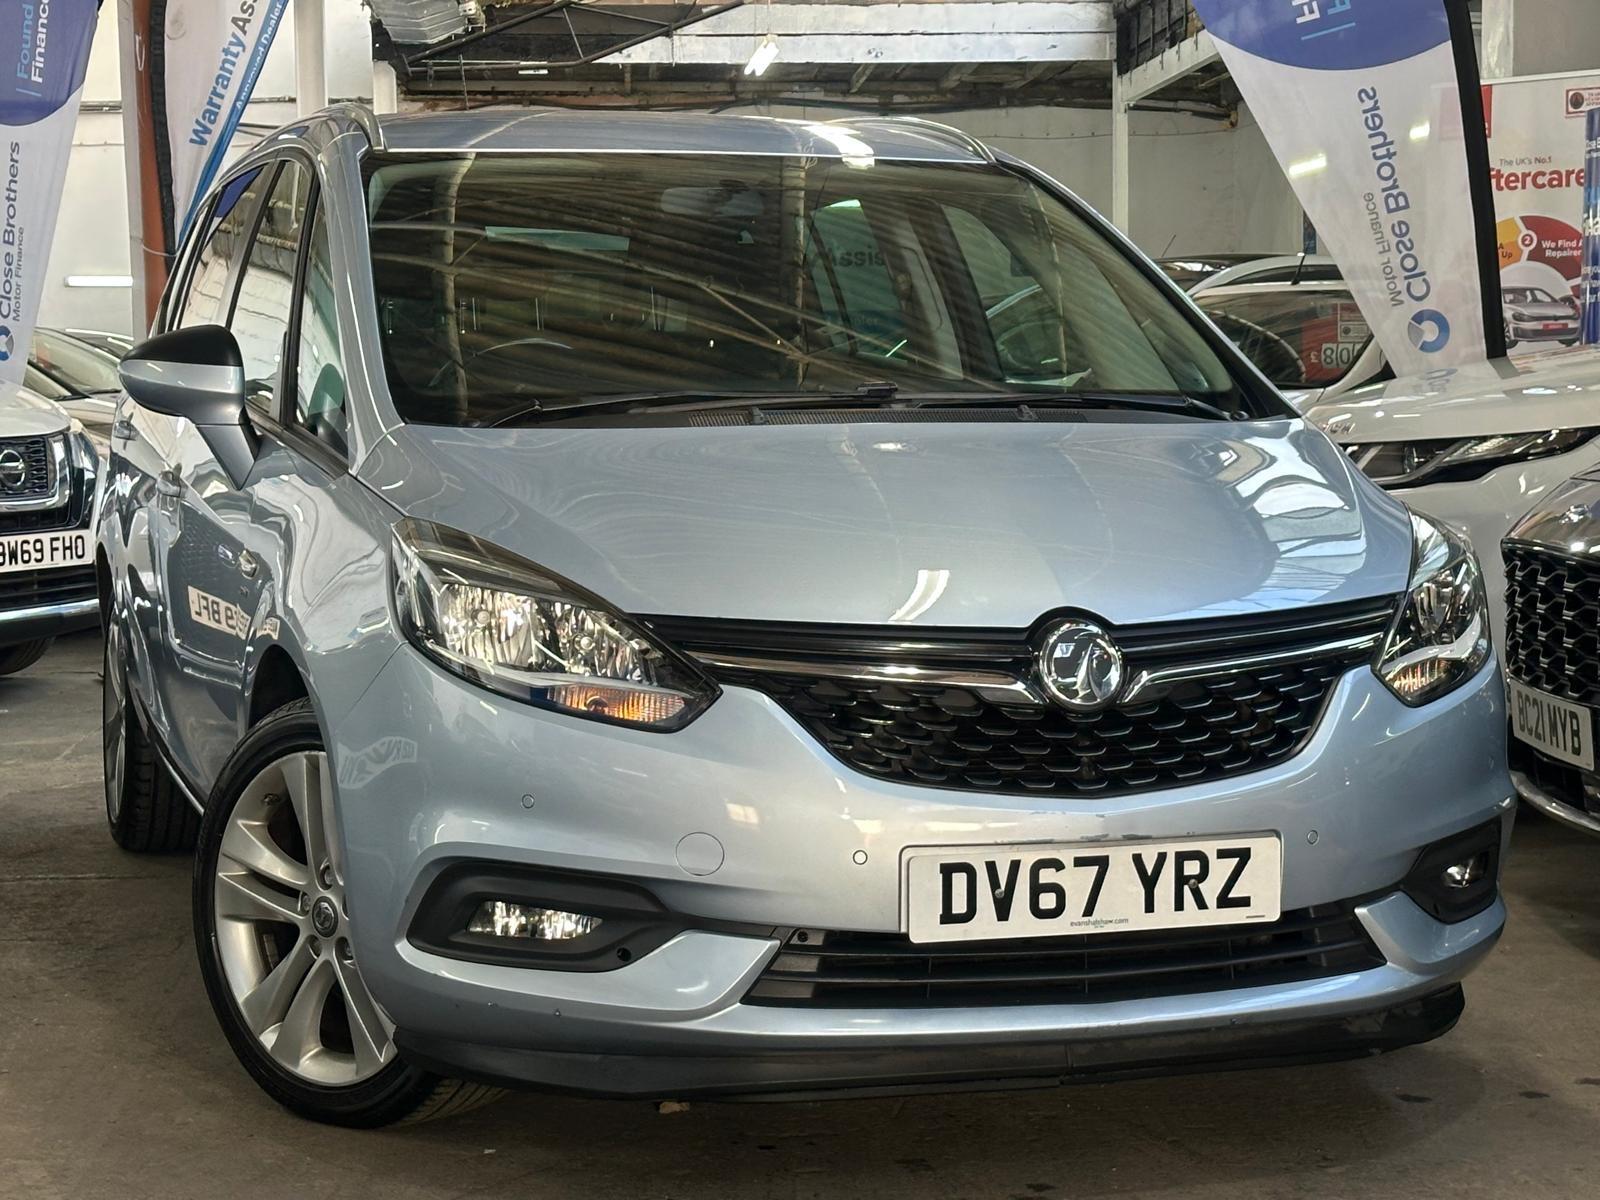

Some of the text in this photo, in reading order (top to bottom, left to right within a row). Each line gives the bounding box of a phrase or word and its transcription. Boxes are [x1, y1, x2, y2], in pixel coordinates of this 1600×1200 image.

[31, 0, 49, 83] Financ
[3, 141, 20, 246] Brothers
[1499, 158, 1514, 166] The
[12, 226, 24, 322] Motor Finance
[1541, 240, 1556, 248] We
[1557, 239, 1577, 248] Find
[1547, 703, 1581, 756] MYB
[939, 847, 1252, 925] DV67 YRZ
